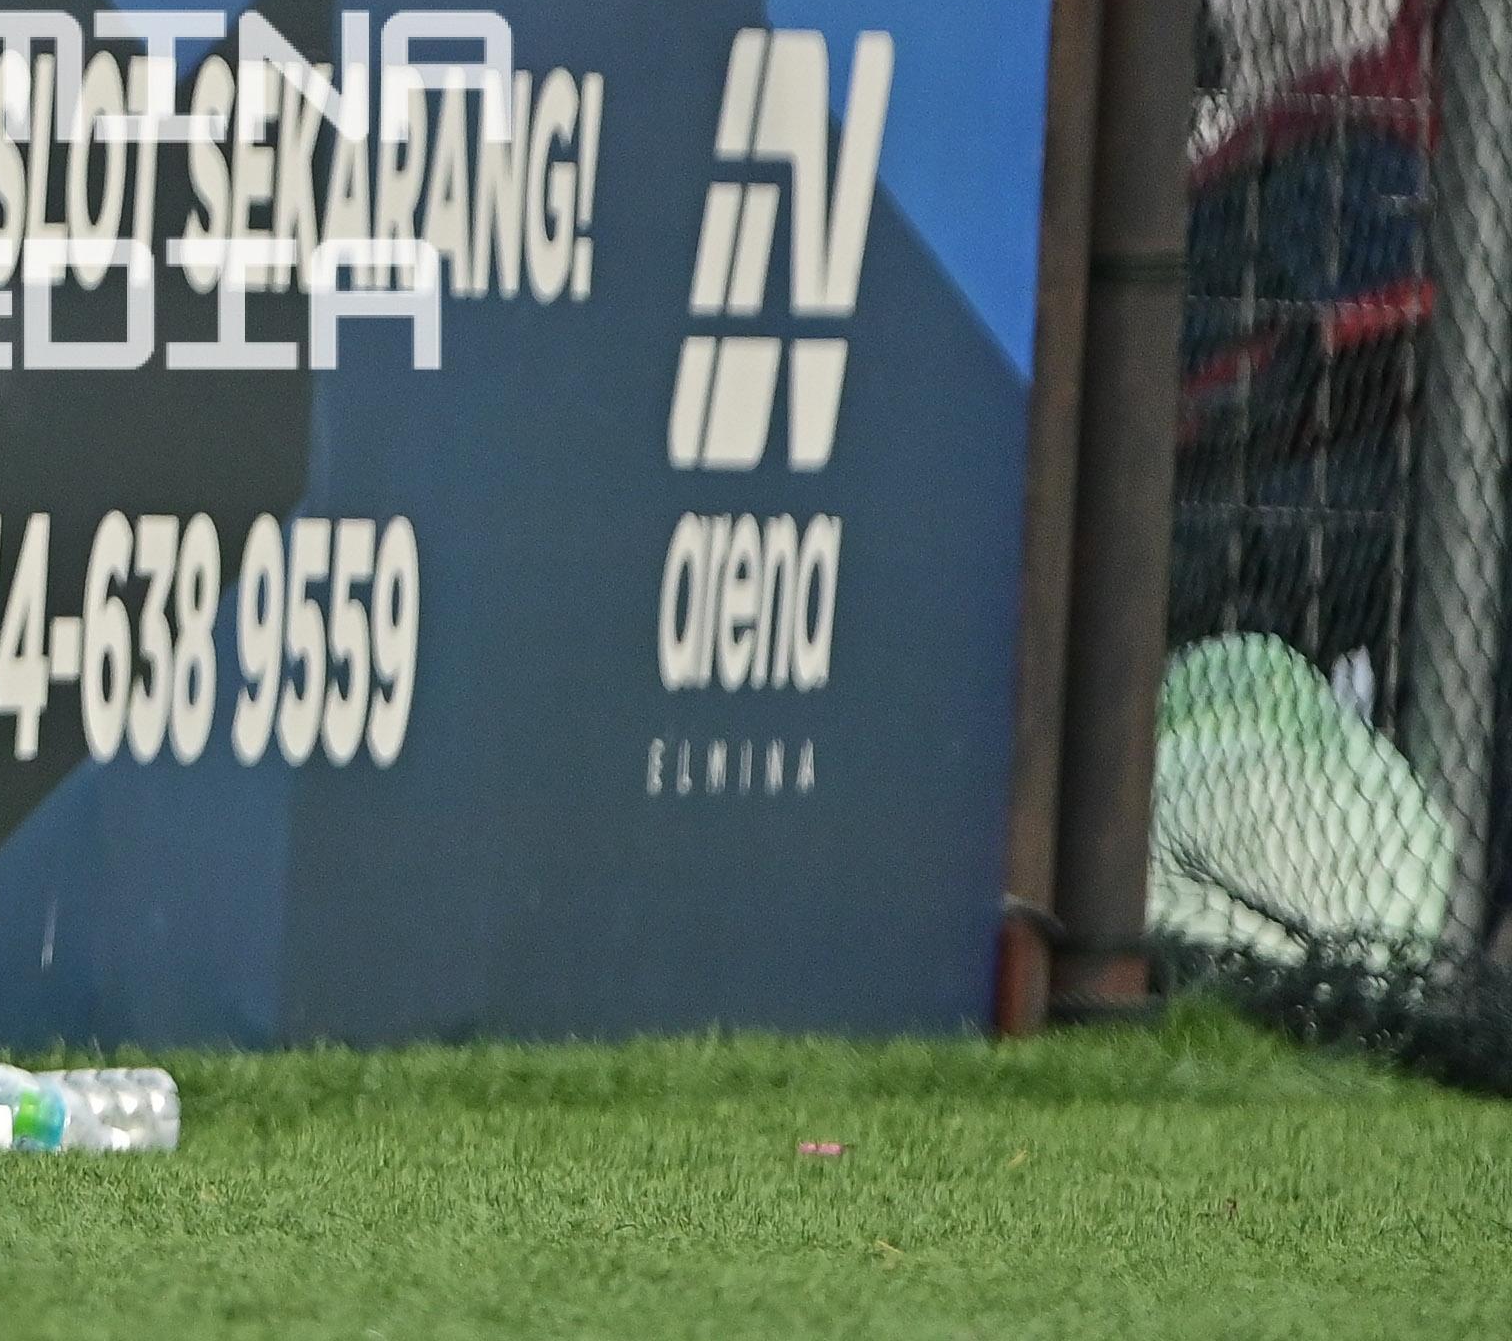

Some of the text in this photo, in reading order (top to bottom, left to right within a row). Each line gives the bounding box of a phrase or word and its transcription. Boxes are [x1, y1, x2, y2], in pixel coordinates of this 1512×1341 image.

[182, 52, 604, 305] SEKARANG!
[230, 513, 421, 768] 9559
[658, 510, 843, 693] arena
[645, 737, 817, 795] ELMINA
